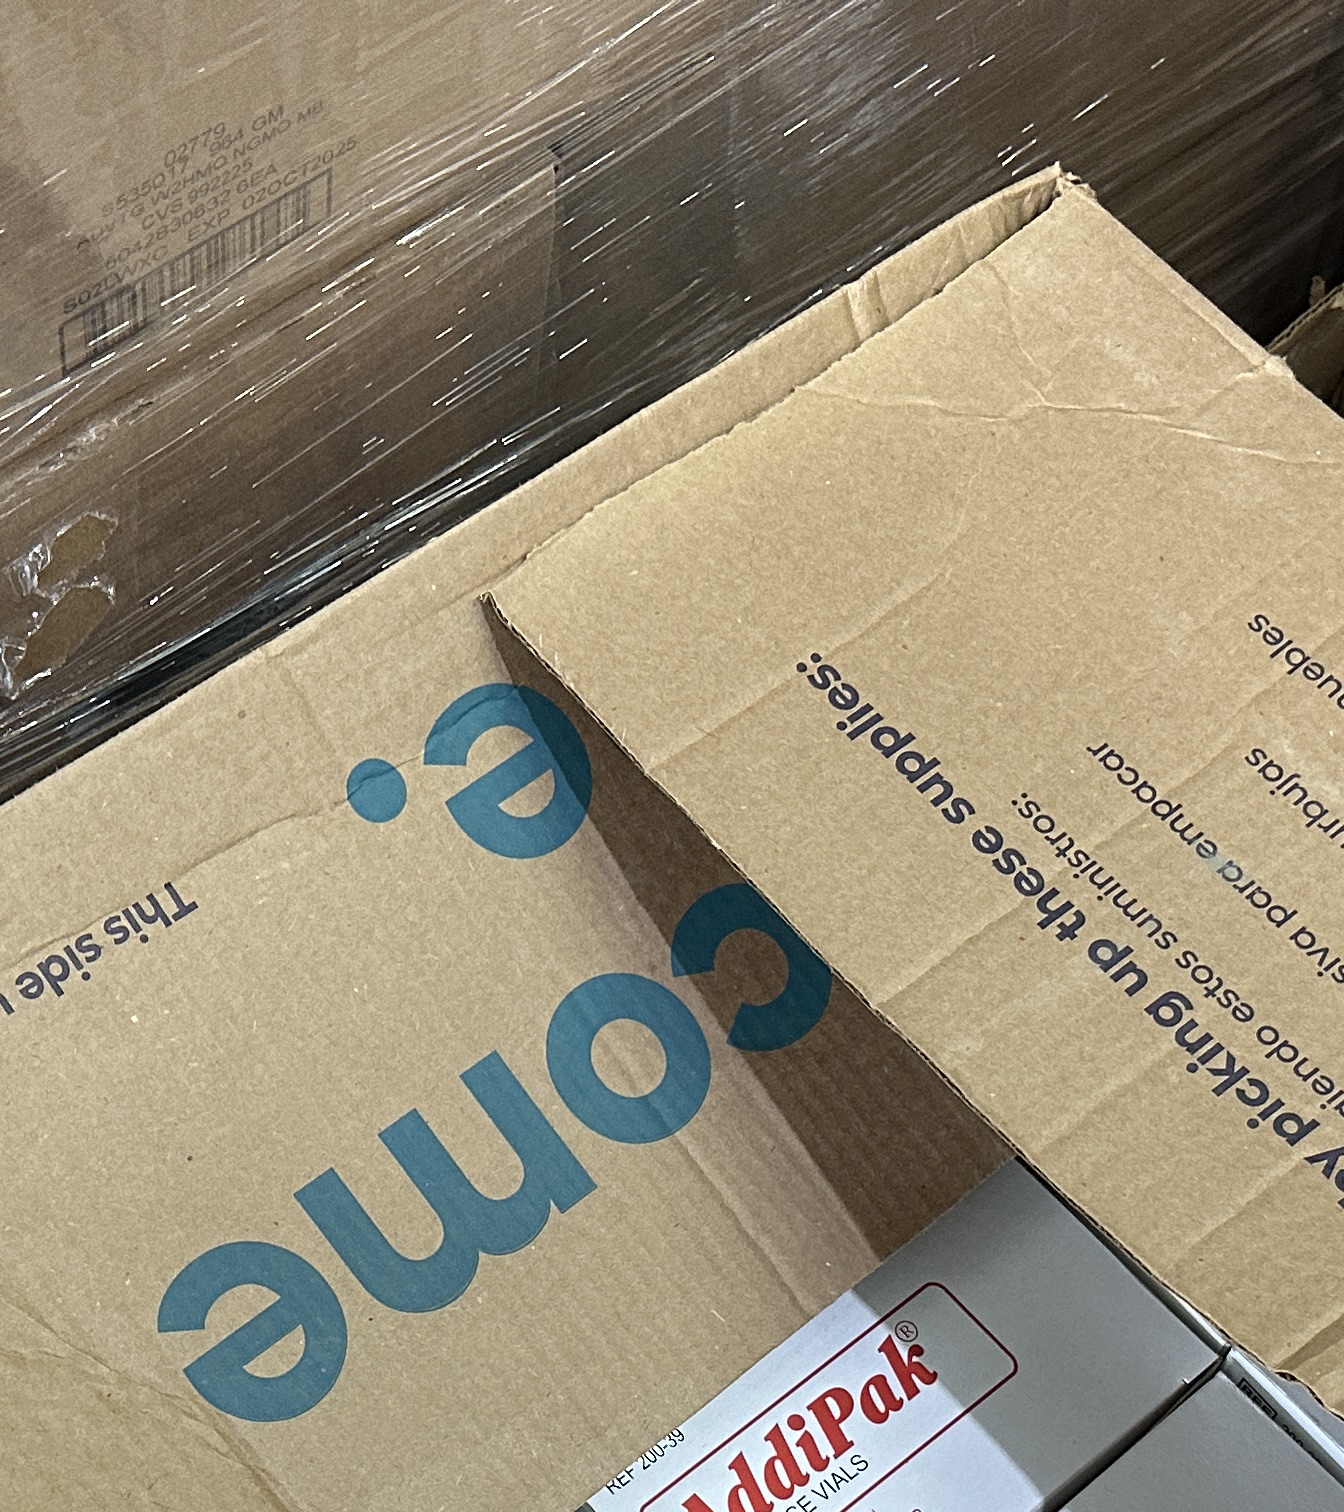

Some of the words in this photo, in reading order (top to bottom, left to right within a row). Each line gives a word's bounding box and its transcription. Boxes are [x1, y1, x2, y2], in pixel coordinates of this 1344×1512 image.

[186, 206, 233, 242] EXP
[797, 653, 975, 824] supplies:
[1087, 743, 1217, 858] empacar
[972, 826, 1085, 941] these
[1012, 793, 1178, 949] suministros:
[1217, 861, 1298, 928] para
[104, 882, 198, 944] This
[15, 933, 103, 999] side
[1088, 939, 1148, 997] up
[1175, 951, 1254, 1022] estos
[1144, 991, 1320, 1146] picking
[603, 1468, 634, 1495] REF
[639, 1428, 684, 1470] 200-39
[811, 1455, 868, 1499] VIALS
